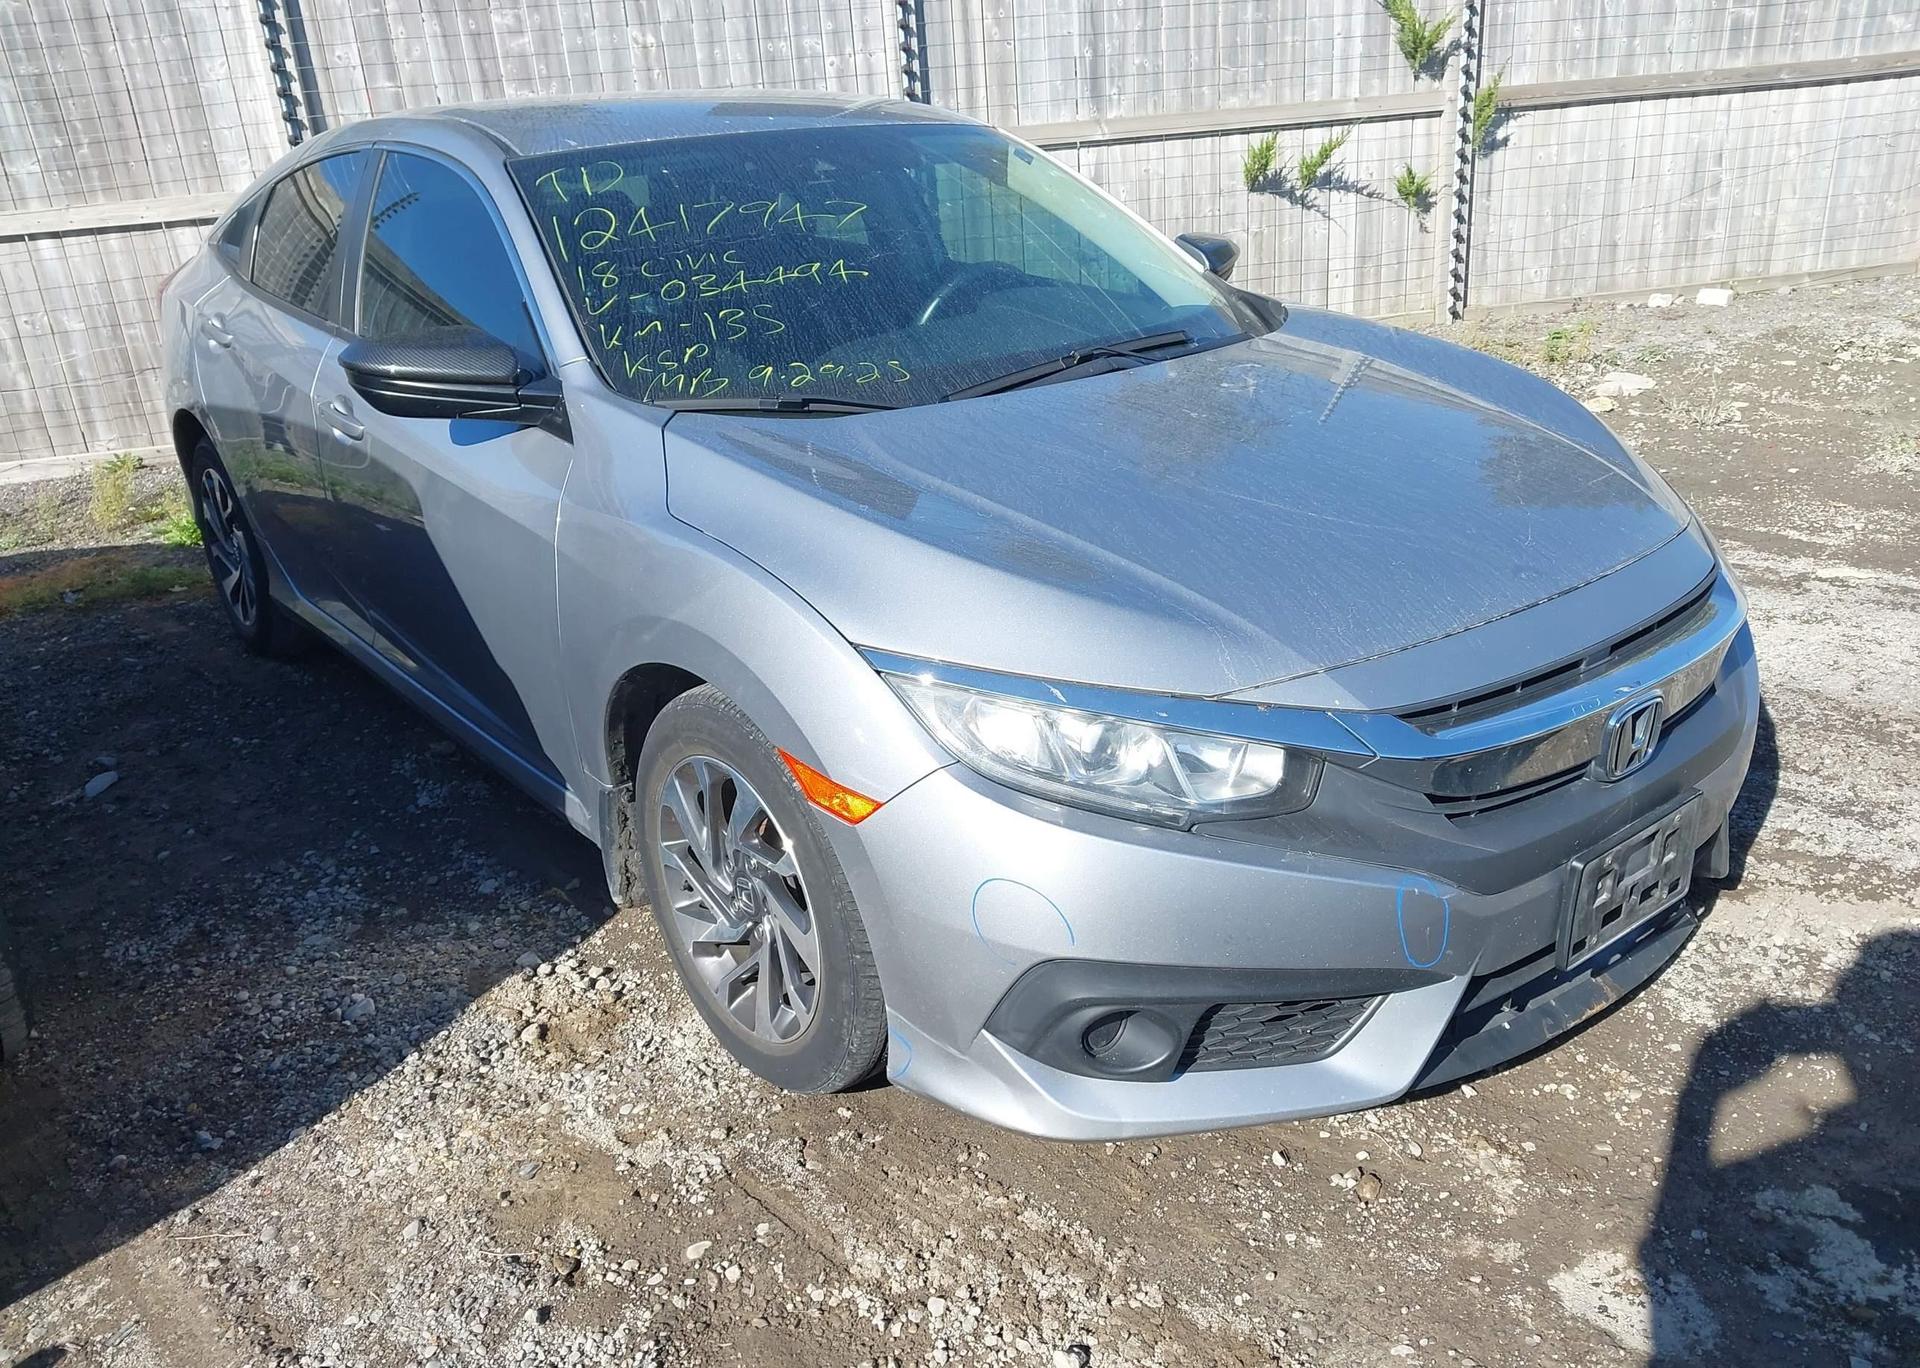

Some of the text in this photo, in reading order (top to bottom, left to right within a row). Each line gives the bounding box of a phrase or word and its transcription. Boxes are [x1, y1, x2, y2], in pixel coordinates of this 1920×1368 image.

[536, 160, 623, 202] TD
[552, 199, 867, 263] 12417947
[577, 260, 619, 292] 18
